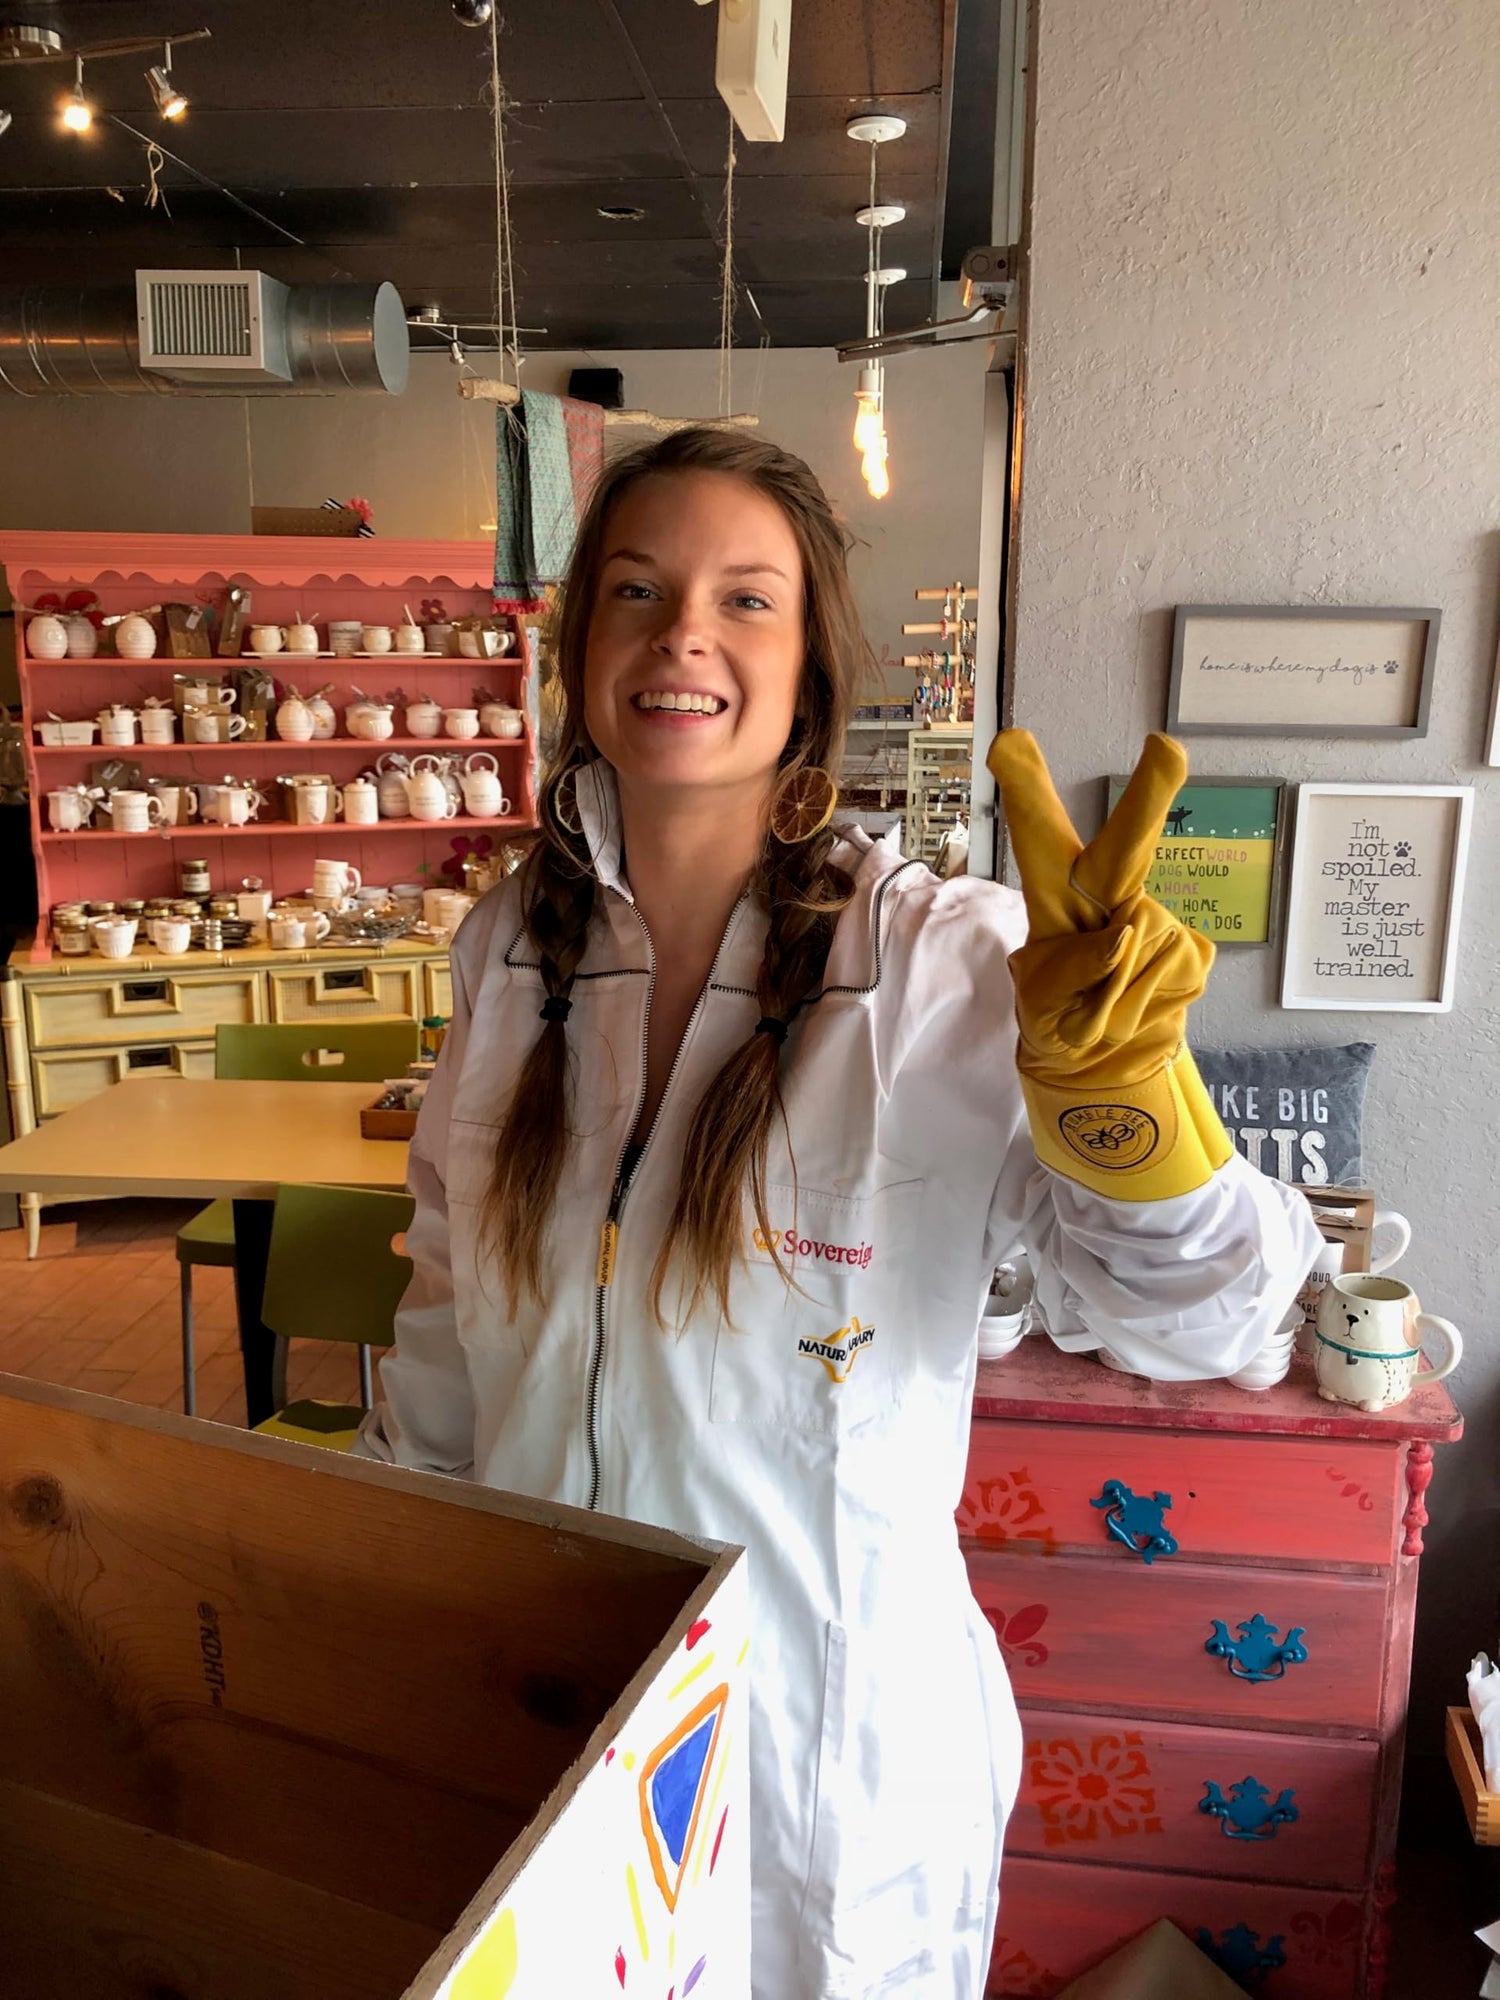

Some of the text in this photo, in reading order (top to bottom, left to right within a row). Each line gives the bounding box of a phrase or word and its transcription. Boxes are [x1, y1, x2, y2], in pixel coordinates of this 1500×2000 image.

[1199, 655, 1379, 686] home is where my dog is
[1350, 818, 1381, 840] I'm
[1155, 846, 1248, 863] ERFECT WORLD
[1347, 838, 1390, 857] not
[1158, 865, 1183, 877] DOG
[1187, 864, 1230, 878] WOULD
[1321, 857, 1422, 881] spoiled.
[1154, 883, 1161, 894] A
[1163, 882, 1200, 895] HOME
[1347, 878, 1380, 901] My
[1182, 898, 1219, 913] HOME
[1324, 897, 1411, 917] master
[1202, 918, 1210, 930] A
[1214, 914, 1242, 930] DOG
[1341, 917, 1425, 940] is just
[1347, 939, 1402, 958] well
[1313, 957, 1414, 978] trained.
[1209, 1084, 1328, 1124] IKE BIG
[1121, 1110, 1150, 1129] BEE
[1228, 1127, 1329, 1184] TTS
[783, 1230, 873, 1269] Sovereig
[798, 1339, 847, 1361] NATUR
